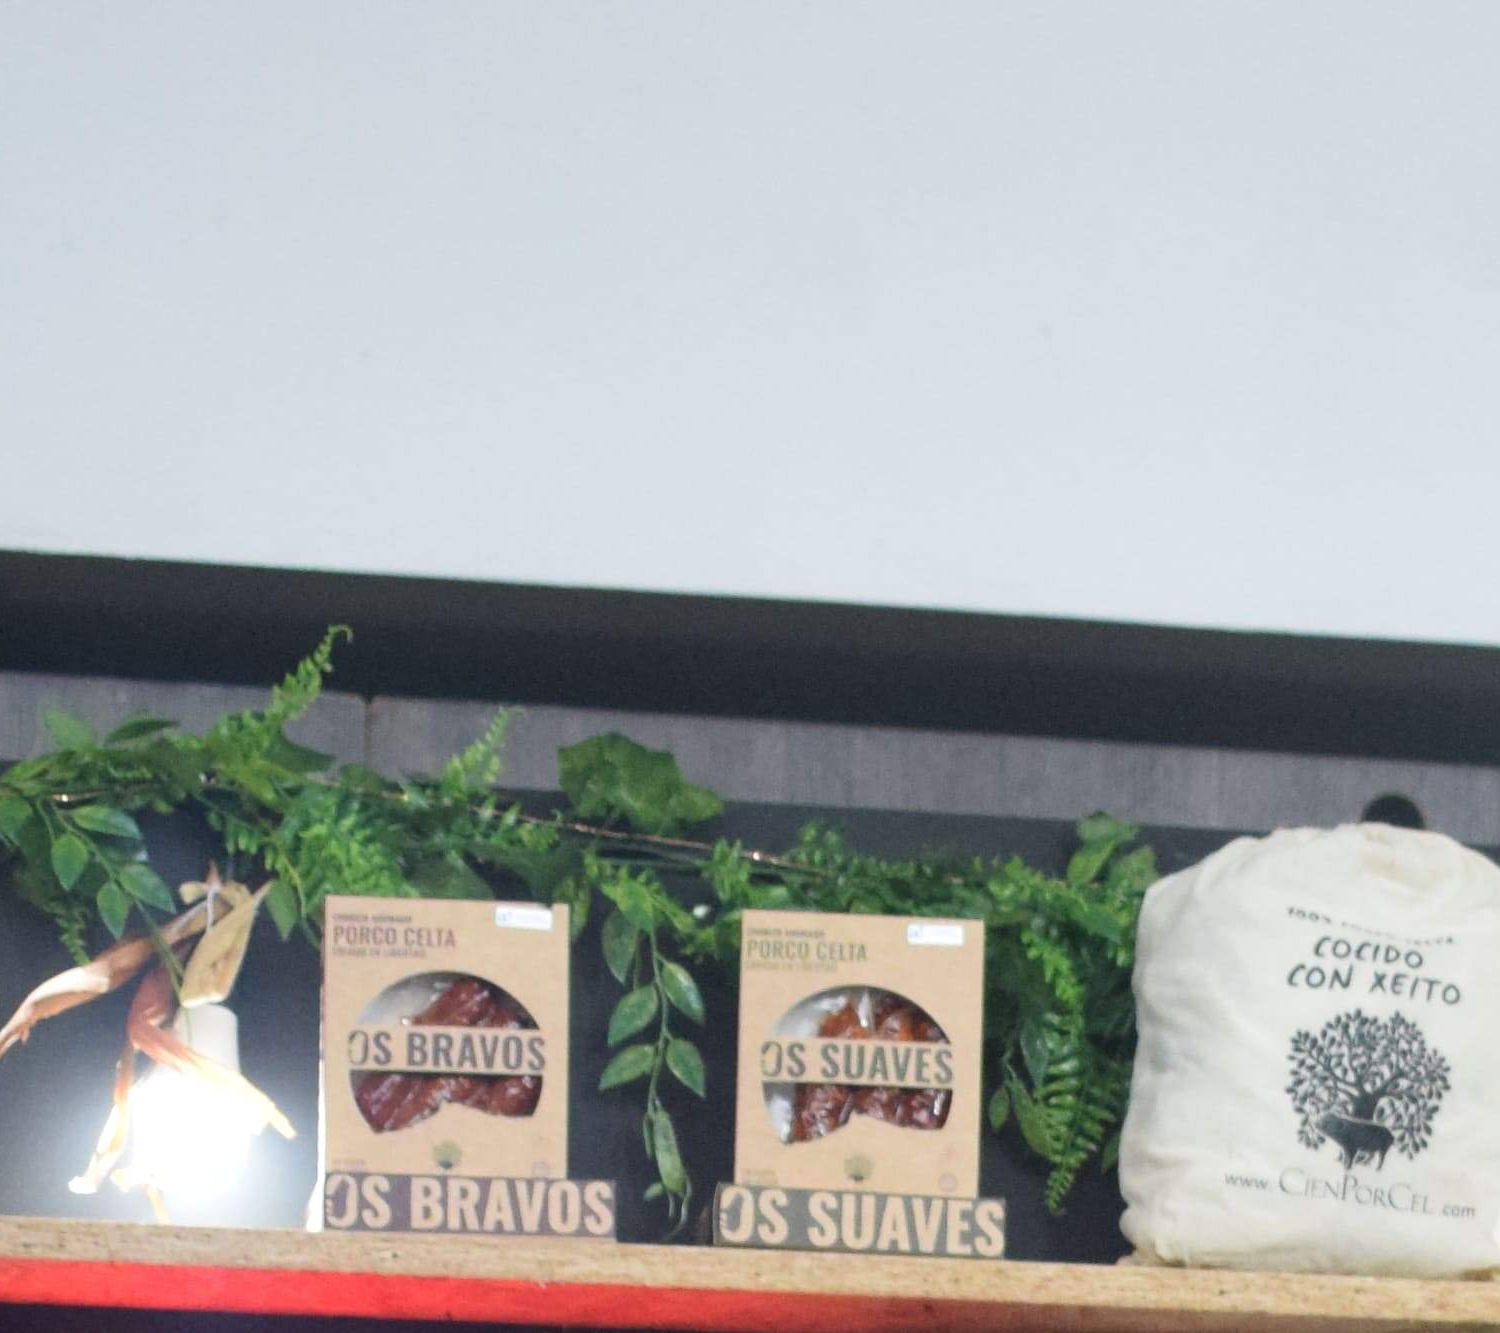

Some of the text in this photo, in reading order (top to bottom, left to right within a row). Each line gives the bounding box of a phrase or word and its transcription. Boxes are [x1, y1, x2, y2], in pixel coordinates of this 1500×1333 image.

[333, 925, 456, 948] PORCO CELTA
[747, 940, 868, 961] PORCO CELTA
[1314, 936, 1424, 969] COCIDO
[1287, 964, 1461, 1005] CON XEITO
[348, 1030, 546, 1071] OS BRAVOS
[761, 1041, 954, 1085] OS SUAVES
[326, 1174, 614, 1235] OS BRAVOS
[719, 1185, 1005, 1257] OS SUAVES
